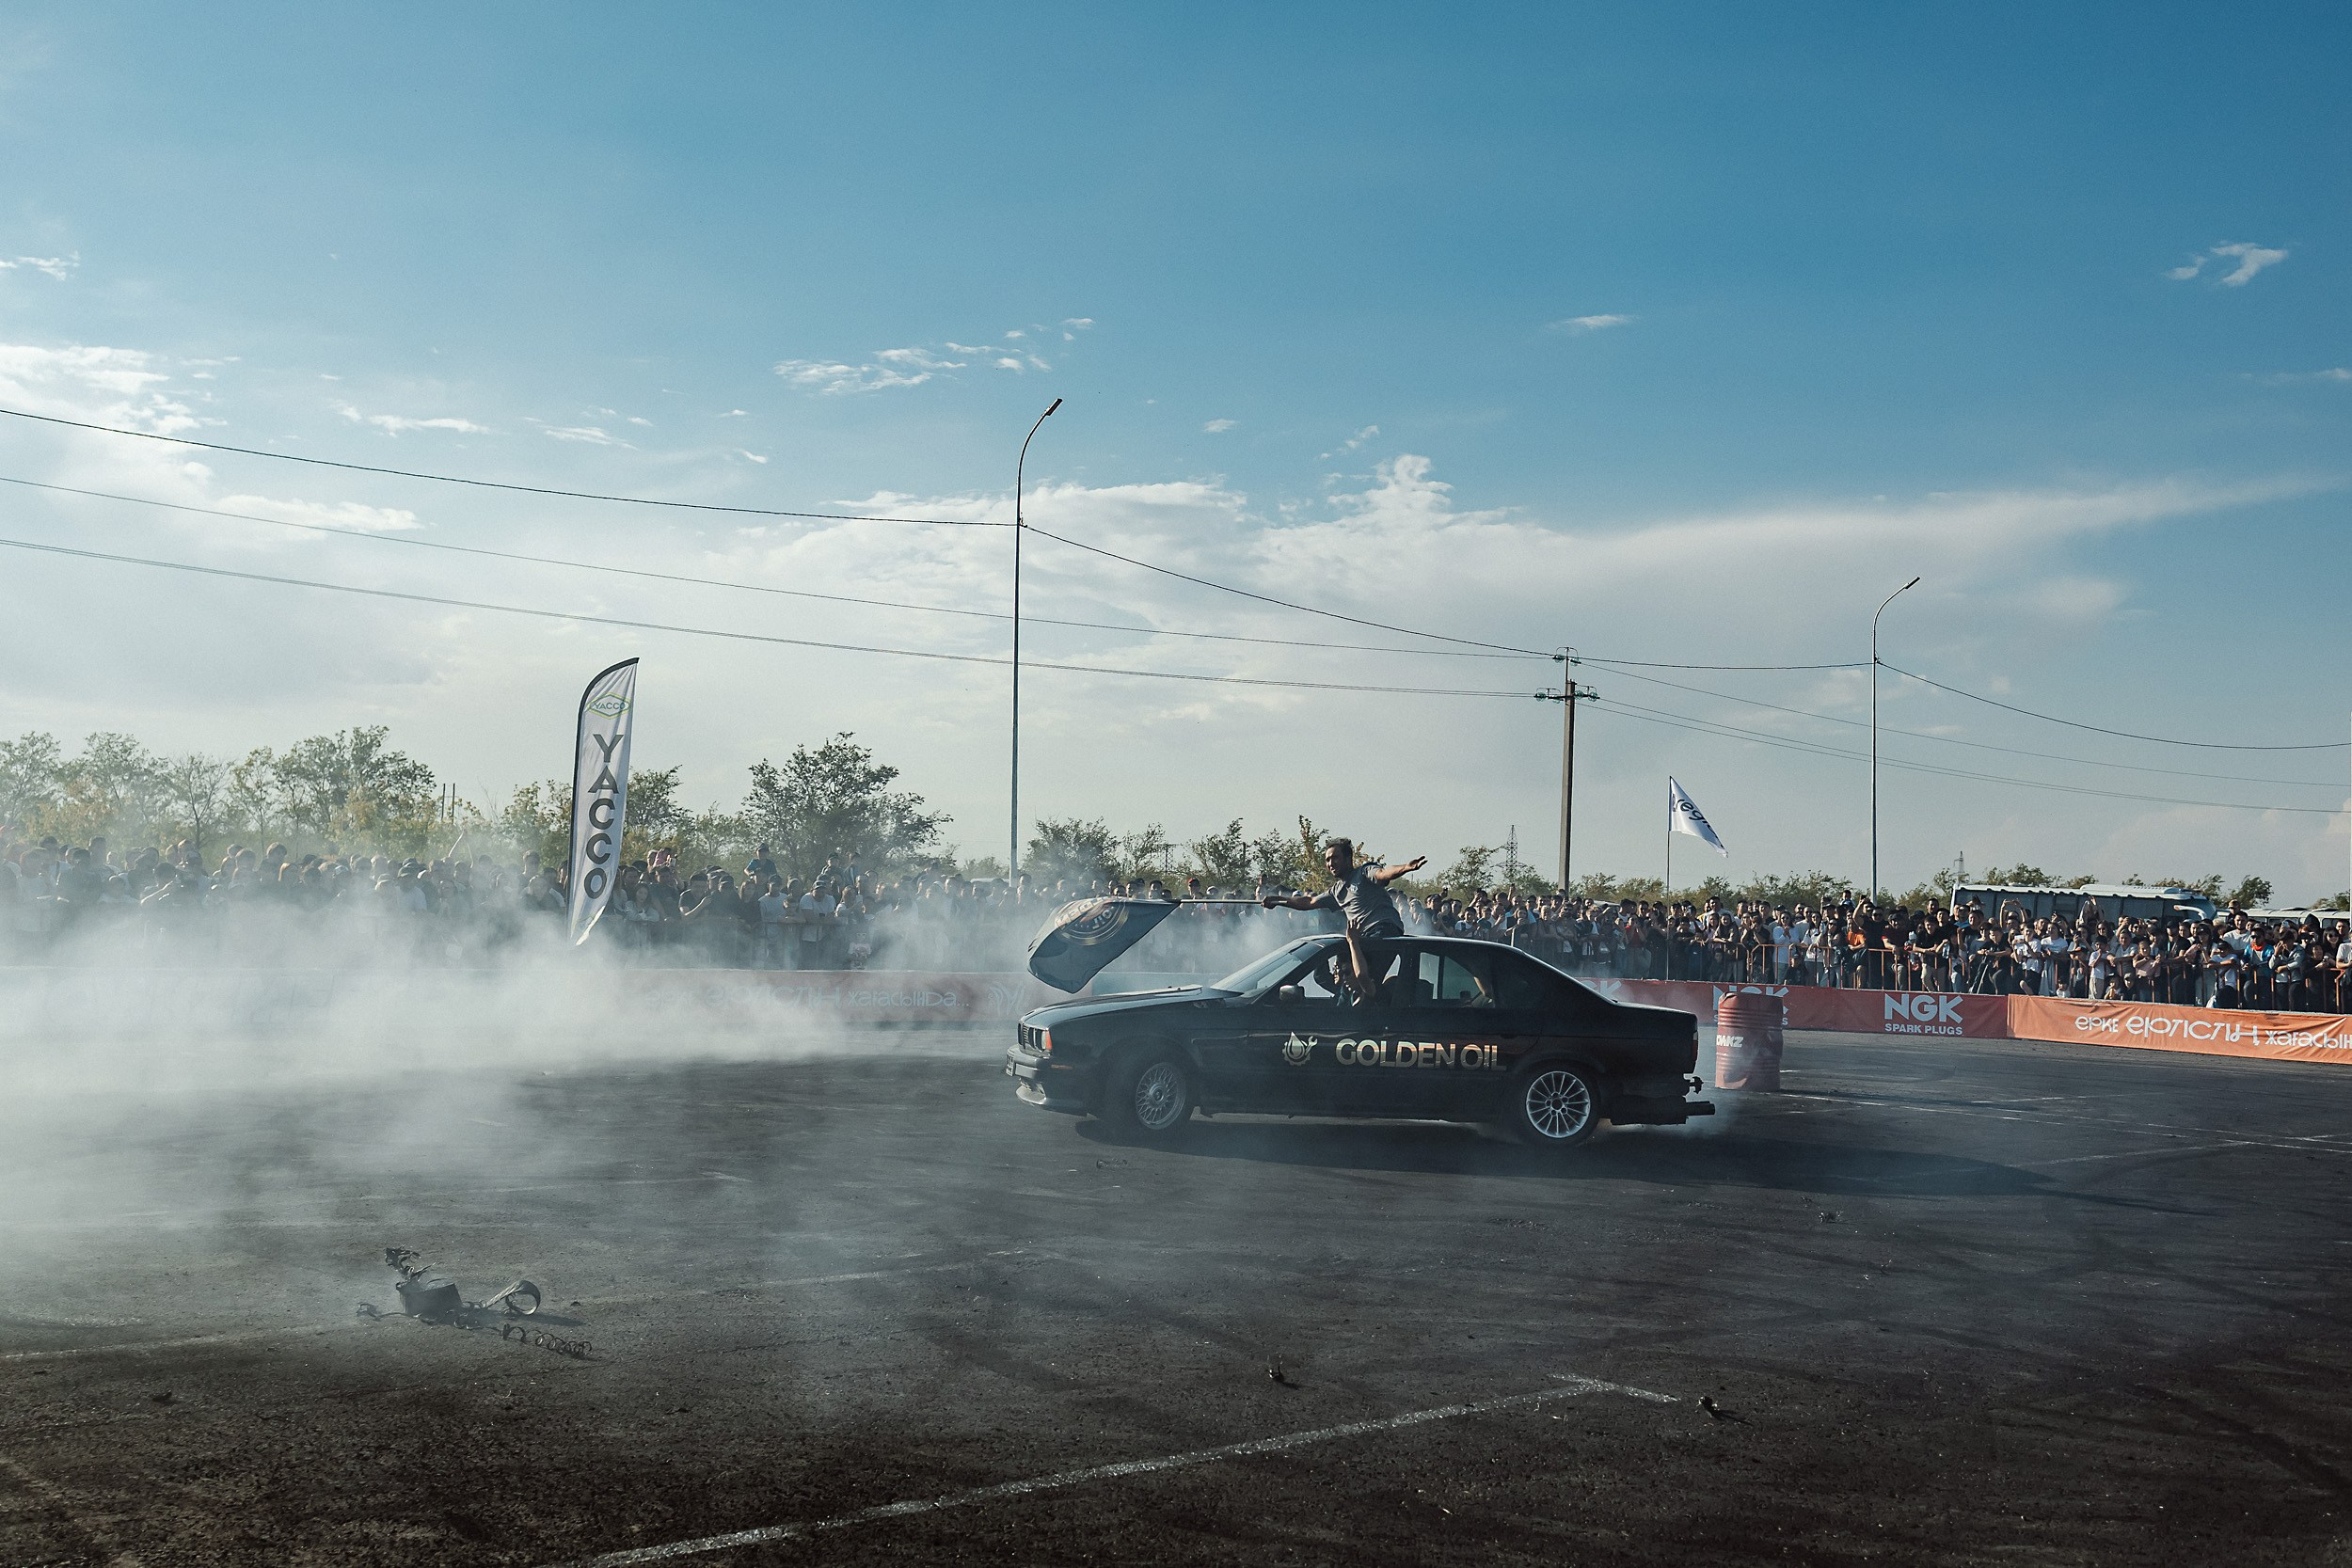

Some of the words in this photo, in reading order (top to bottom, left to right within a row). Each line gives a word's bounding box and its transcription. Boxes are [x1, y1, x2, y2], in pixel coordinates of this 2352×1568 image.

[595, 702, 626, 710] YACCO
[583, 734, 624, 899] YACCO
[1884, 993, 1963, 1024] NGK
[1884, 1023, 1922, 1034] SPARK
[1924, 1025, 1963, 1036] PLUGS
[1336, 1038, 1456, 1069] GOLDEN
[1460, 1043, 1507, 1071] OIL
